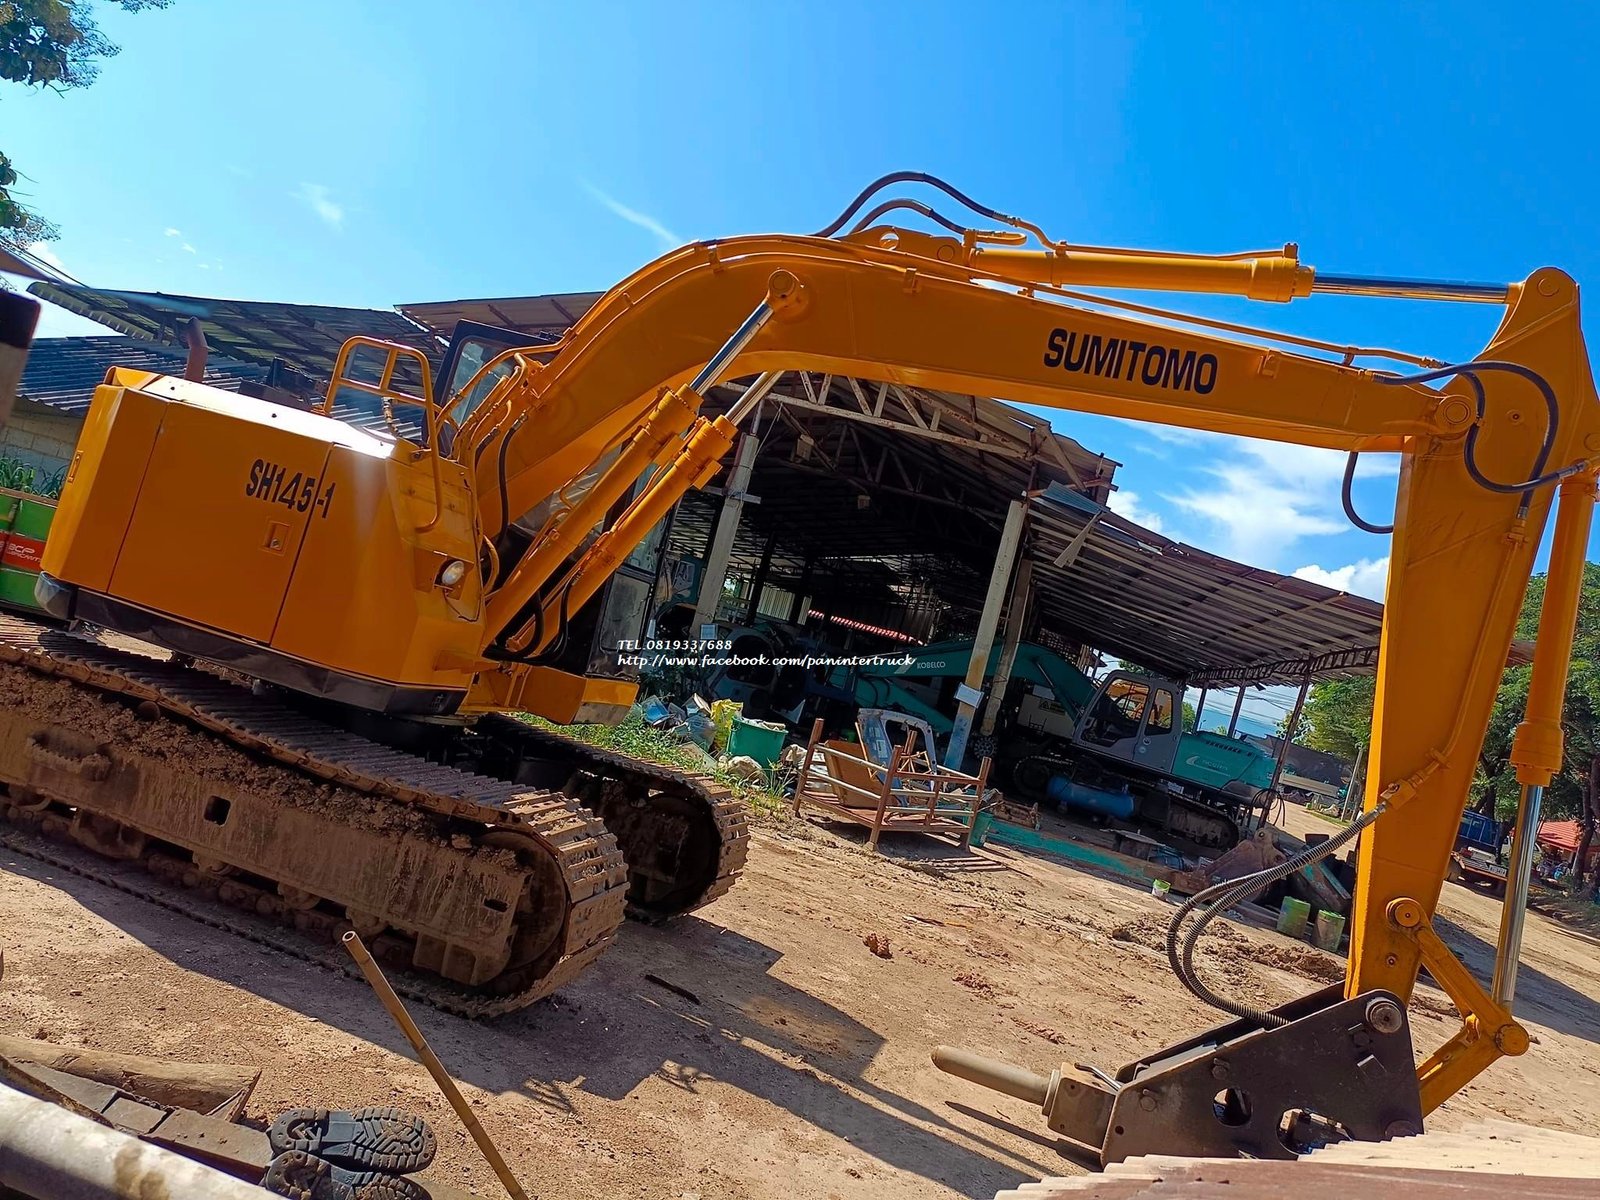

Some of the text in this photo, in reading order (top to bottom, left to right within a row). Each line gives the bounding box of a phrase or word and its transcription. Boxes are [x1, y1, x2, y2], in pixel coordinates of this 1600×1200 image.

[1043, 328, 1218, 395] SUMITOMO
[246, 458, 336, 519] SH145-1
[916, 661, 946, 669] KOBELCO
